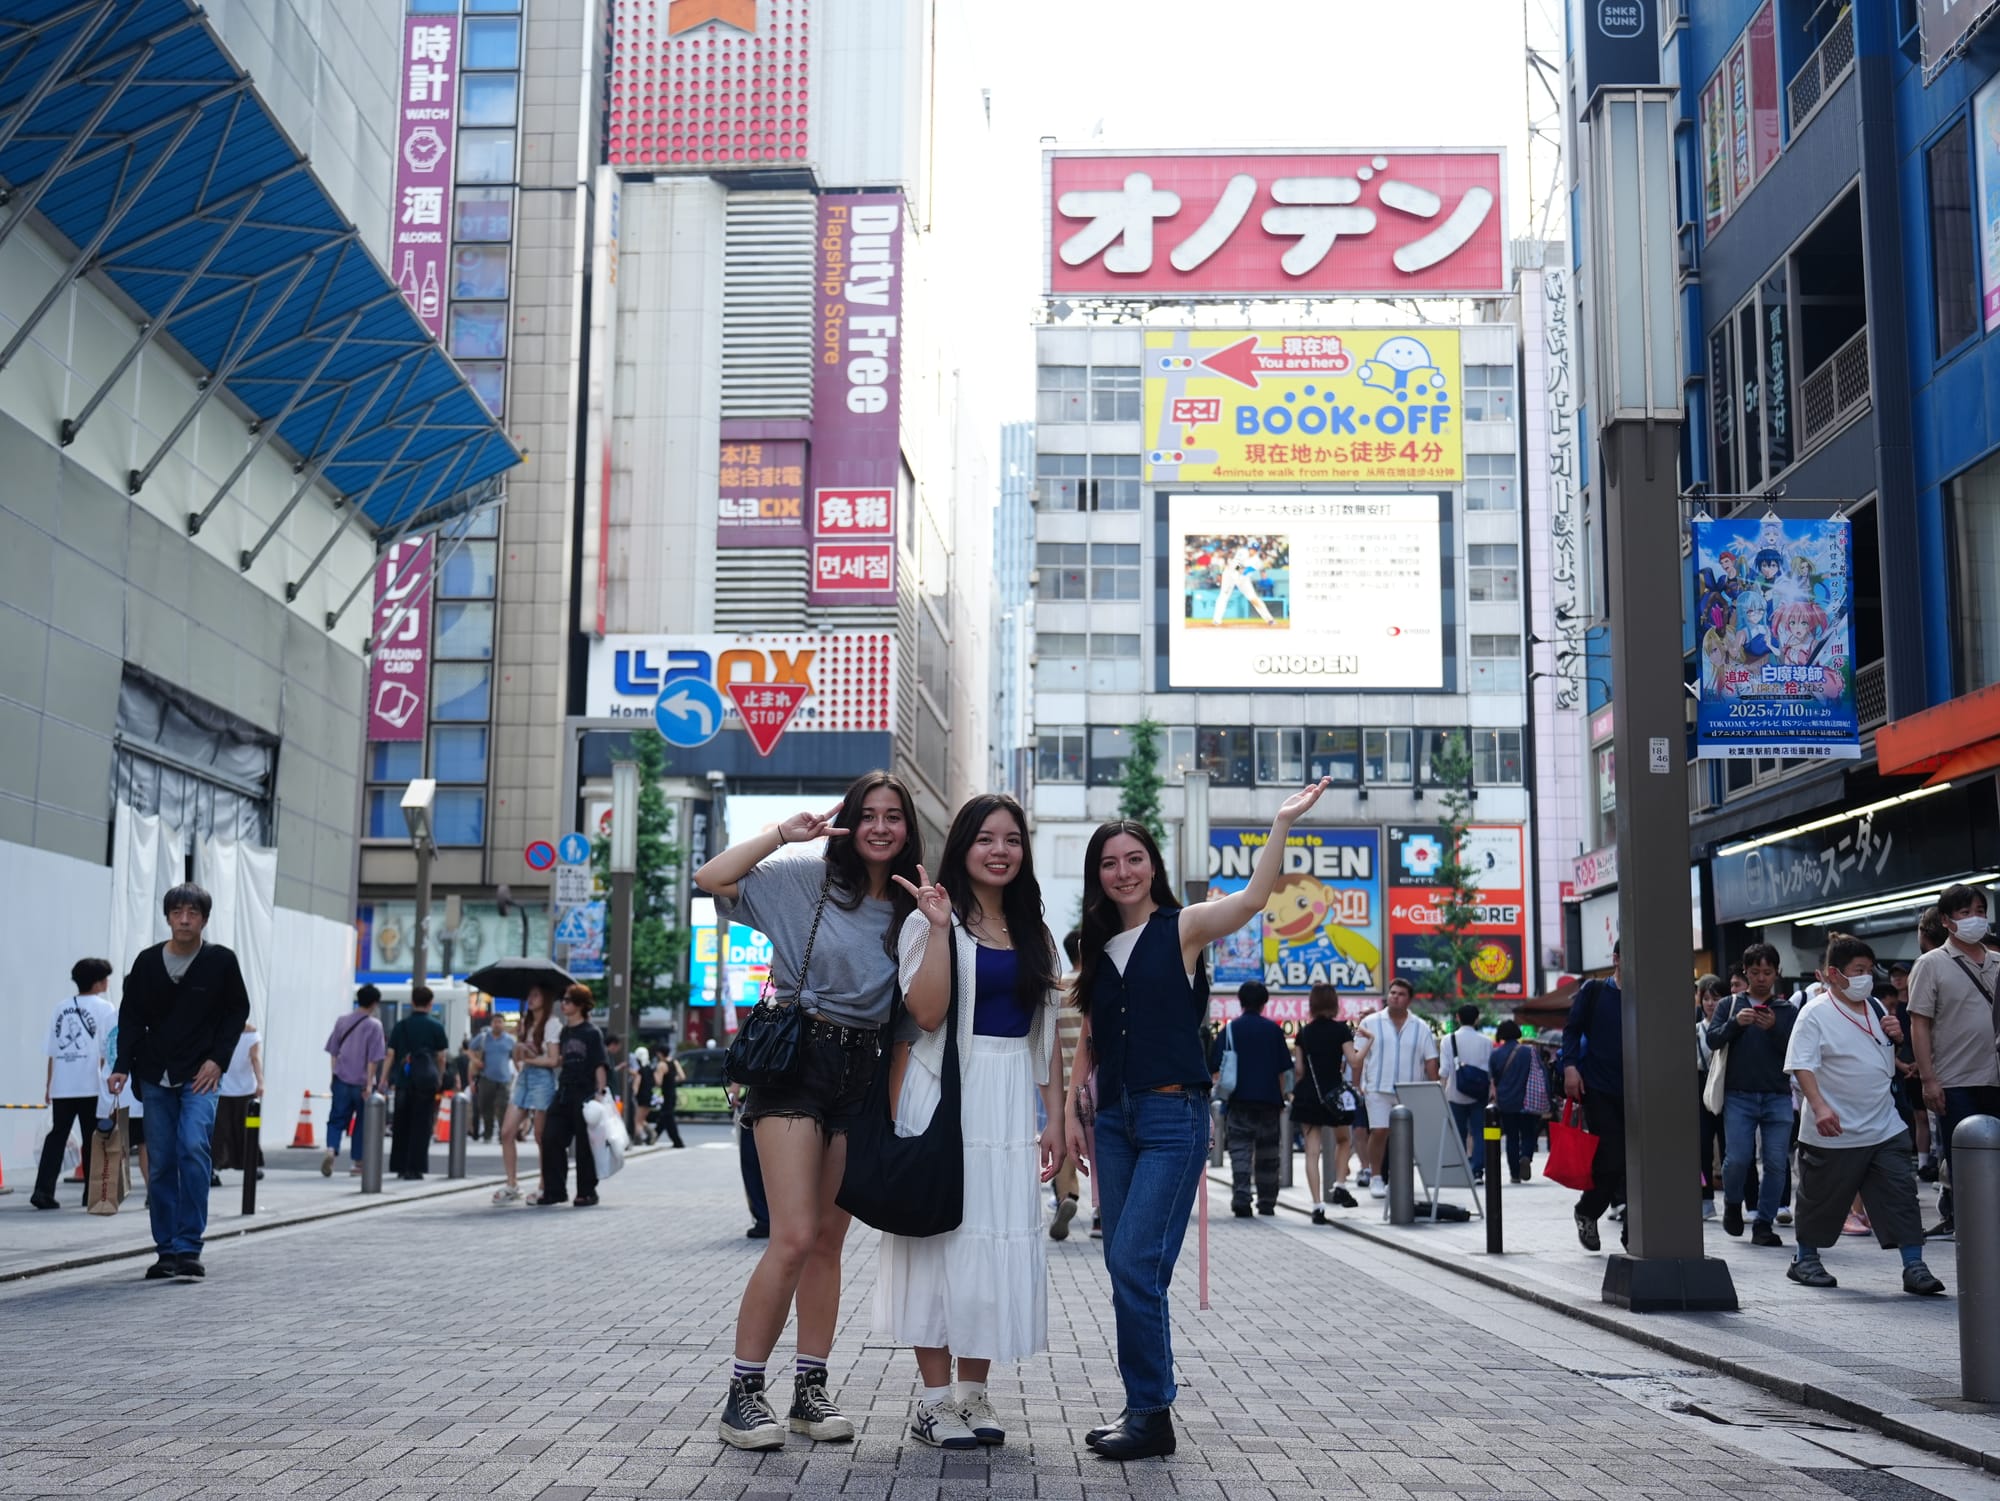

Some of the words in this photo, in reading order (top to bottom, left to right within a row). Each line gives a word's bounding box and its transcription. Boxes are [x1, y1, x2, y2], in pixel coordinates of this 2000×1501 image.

[1604, 6, 1637, 16] SNKR
[1604, 16, 1638, 26] DUNK
[408, 25, 452, 102] 時計
[405, 108, 450, 120] WATCH
[401, 186, 444, 225] 酒
[1057, 156, 1493, 275] オノデン
[398, 231, 443, 244] ALCOHOL
[822, 205, 848, 296] Flagship
[844, 205, 899, 306] Duty
[823, 303, 846, 365] Store
[1282, 337, 1342, 356] 現在地
[847, 315, 897, 414] Free
[1257, 356, 1282, 369] You
[1284, 358, 1309, 369] are
[1311, 356, 1345, 369] here
[1175, 402, 1217, 420] ここ!
[720, 445, 762, 465] 本店
[1245, 441, 1443, 464] 現在地から徒歩4分
[719, 466, 802, 487] 総合家電
[1268, 467, 1296, 478] walk
[1299, 467, 1328, 478] from
[1331, 467, 1360, 478] here
[821, 496, 888, 528] 免税
[818, 555, 889, 580] 면세점
[378, 647, 422, 661] TRADING
[384, 661, 414, 674] CARD
[1253, 655, 1359, 674] ONODEN
[742, 690, 792, 708] 止まれ
[749, 710, 785, 725] STOP
[1239, 833, 1304, 847] Welme
[1305, 834, 1324, 846] to
[1767, 810, 1893, 905] トレカならスニダン
[1264, 962, 1373, 986] ABARA
[1265, 1000, 1297, 1018] TAX
